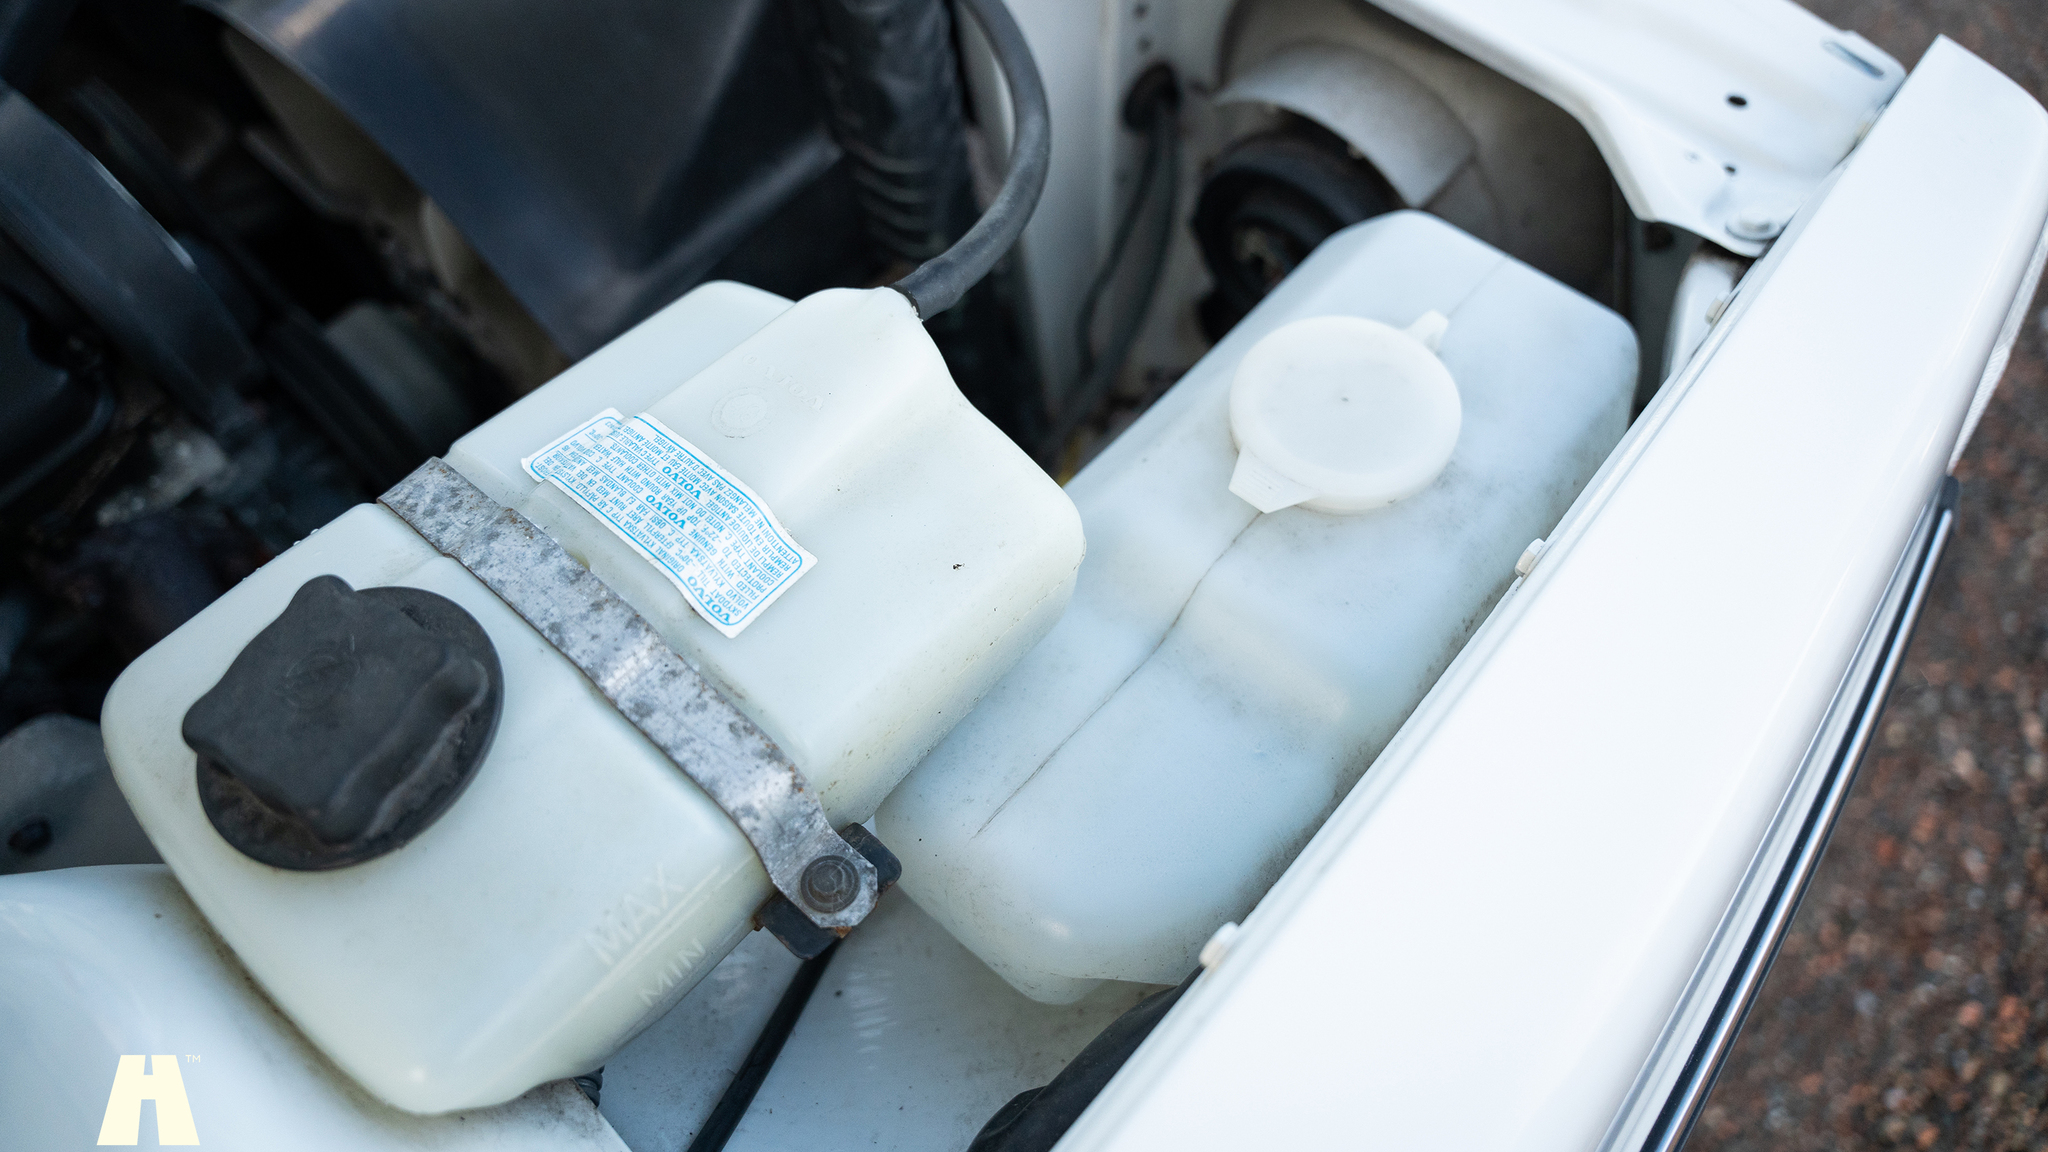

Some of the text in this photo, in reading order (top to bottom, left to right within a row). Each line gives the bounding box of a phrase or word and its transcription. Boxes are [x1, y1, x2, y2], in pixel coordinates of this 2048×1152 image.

[617, 434, 644, 455] VALABLE
[640, 438, 665, 457] MOITIÉ
[609, 455, 627, 469] HALF
[639, 449, 648, 458] C
[642, 452, 661, 467] TYPE
[659, 452, 671, 462] ET
[673, 449, 701, 472] D'AUTRE
[584, 464, 602, 478] MED
[600, 460, 618, 475] TYPE
[623, 464, 642, 481] WITH
[635, 460, 658, 479] OTHER
[667, 457, 683, 471] EAU
[575, 469, 589, 481] DEL
[585, 477, 598, 489] EN
[653, 474, 672, 491] WITH
[678, 466, 703, 486] MOITIÉ
[696, 467, 715, 482] AVEC
[594, 484, 611, 499] MED
[598, 474, 628, 498] BLANDAS
[615, 472, 644, 495] COOLANT
[639, 476, 663, 496] ROUND
[661, 466, 701, 501] VOLVO
[698, 481, 718, 497] AVEC
[710, 478, 727, 492] PAS
[625, 495, 637, 506] EJ
[660, 492, 678, 509] YEAR
[669, 486, 685, 501] MIX
[605, 505, 615, 515] C
[608, 495, 628, 512] RUNT
[635, 502, 651, 517] FÅR
[675, 505, 689, 517] UP
[681, 496, 698, 511] NOT
[704, 498, 733, 522] ANTIGEL
[713, 492, 740, 515] SAISON
[722, 487, 758, 519] MELANGEZ
[610, 511, 625, 523] TYP
[625, 509, 645, 525] ÅRET
[644, 494, 687, 531] VOLVO
[685, 513, 702, 527] TOP
[694, 506, 708, 518] DO
[648, 514, 667, 530] OBS!
[735, 511, 757, 536] TOUTE
[753, 516, 765, 530] NE
[642, 521, 675, 551] EFTERFYLL
[728, 518, 754, 549] LIQUIDE
[752, 533, 765, 547] EN
[674, 536, 690, 549] TYP
[687, 528, 719, 557] GENUINE
[729, 539, 746, 560] TYPE
[760, 526, 800, 565] ATTENTION!
[654, 545, 686, 574] ORIGINAL
[720, 545, 733, 560] TO
[748, 545, 761, 559] DE
[761, 544, 792, 573] REMPLIR
[716, 557, 735, 580] WITH
[742, 558, 776, 587] COOLANT
[757, 554, 785, 579] REMPLI
[696, 569, 711, 588] TILL
[729, 558, 768, 594] PROTECTED
[734, 579, 760, 602] FILLED
[686, 576, 730, 624] VOLVO
[709, 588, 743, 618] SKYDDAT
[724, 588, 750, 611] VOLVO
[585, 864, 686, 966] MAX
[639, 939, 706, 1007] MIN
